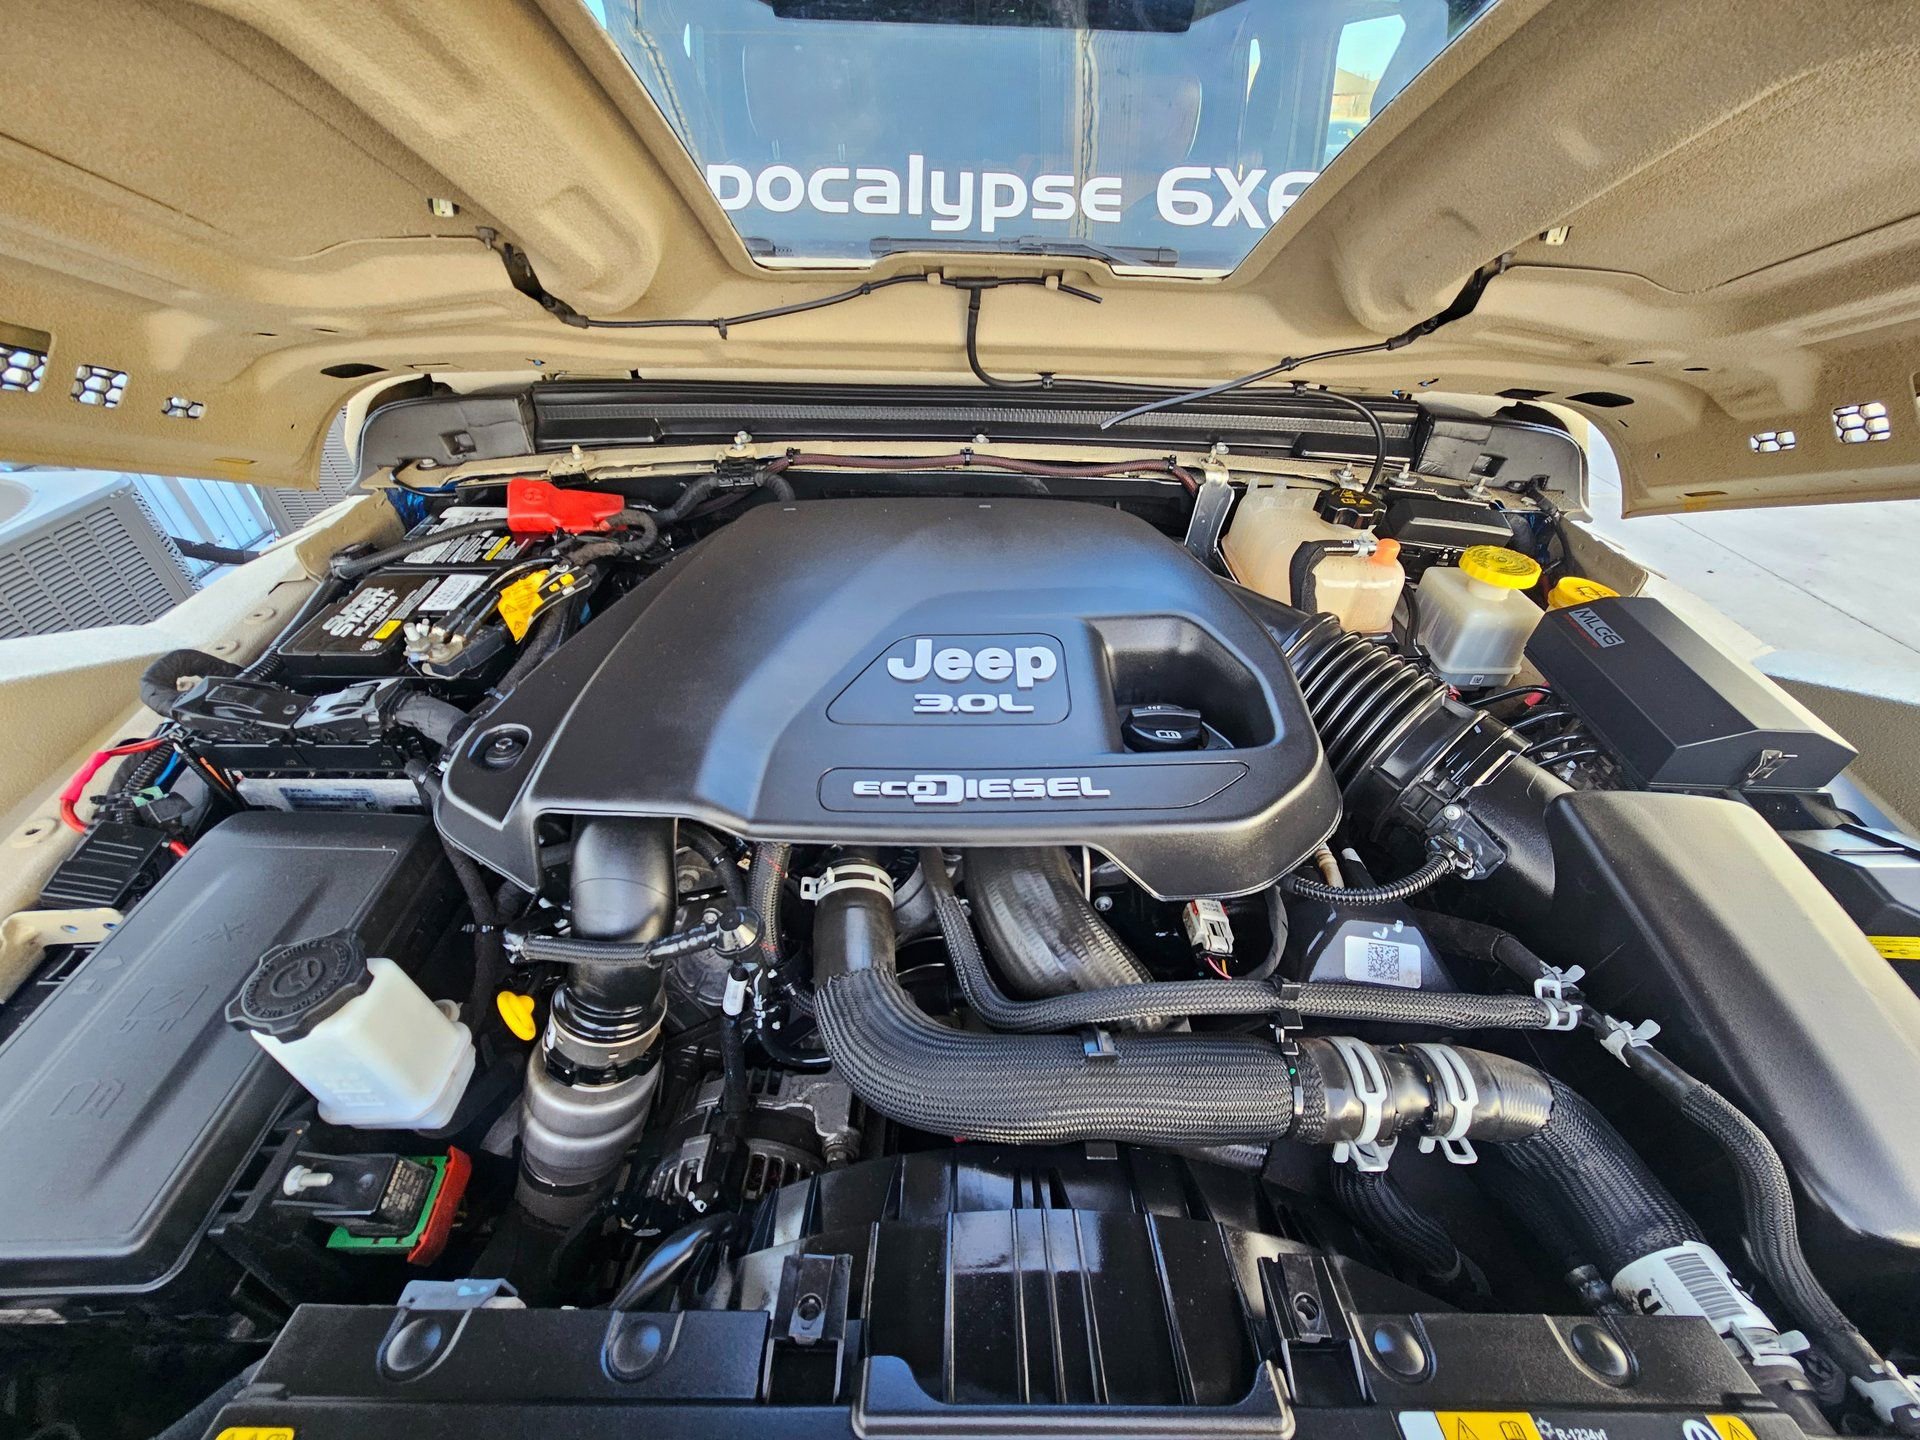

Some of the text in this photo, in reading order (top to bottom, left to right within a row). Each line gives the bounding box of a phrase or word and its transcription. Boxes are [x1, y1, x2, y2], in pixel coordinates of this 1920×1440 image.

[330, 588, 391, 638] START
[886, 638, 1058, 689] Jeep
[913, 693, 1035, 714] 3.0L
